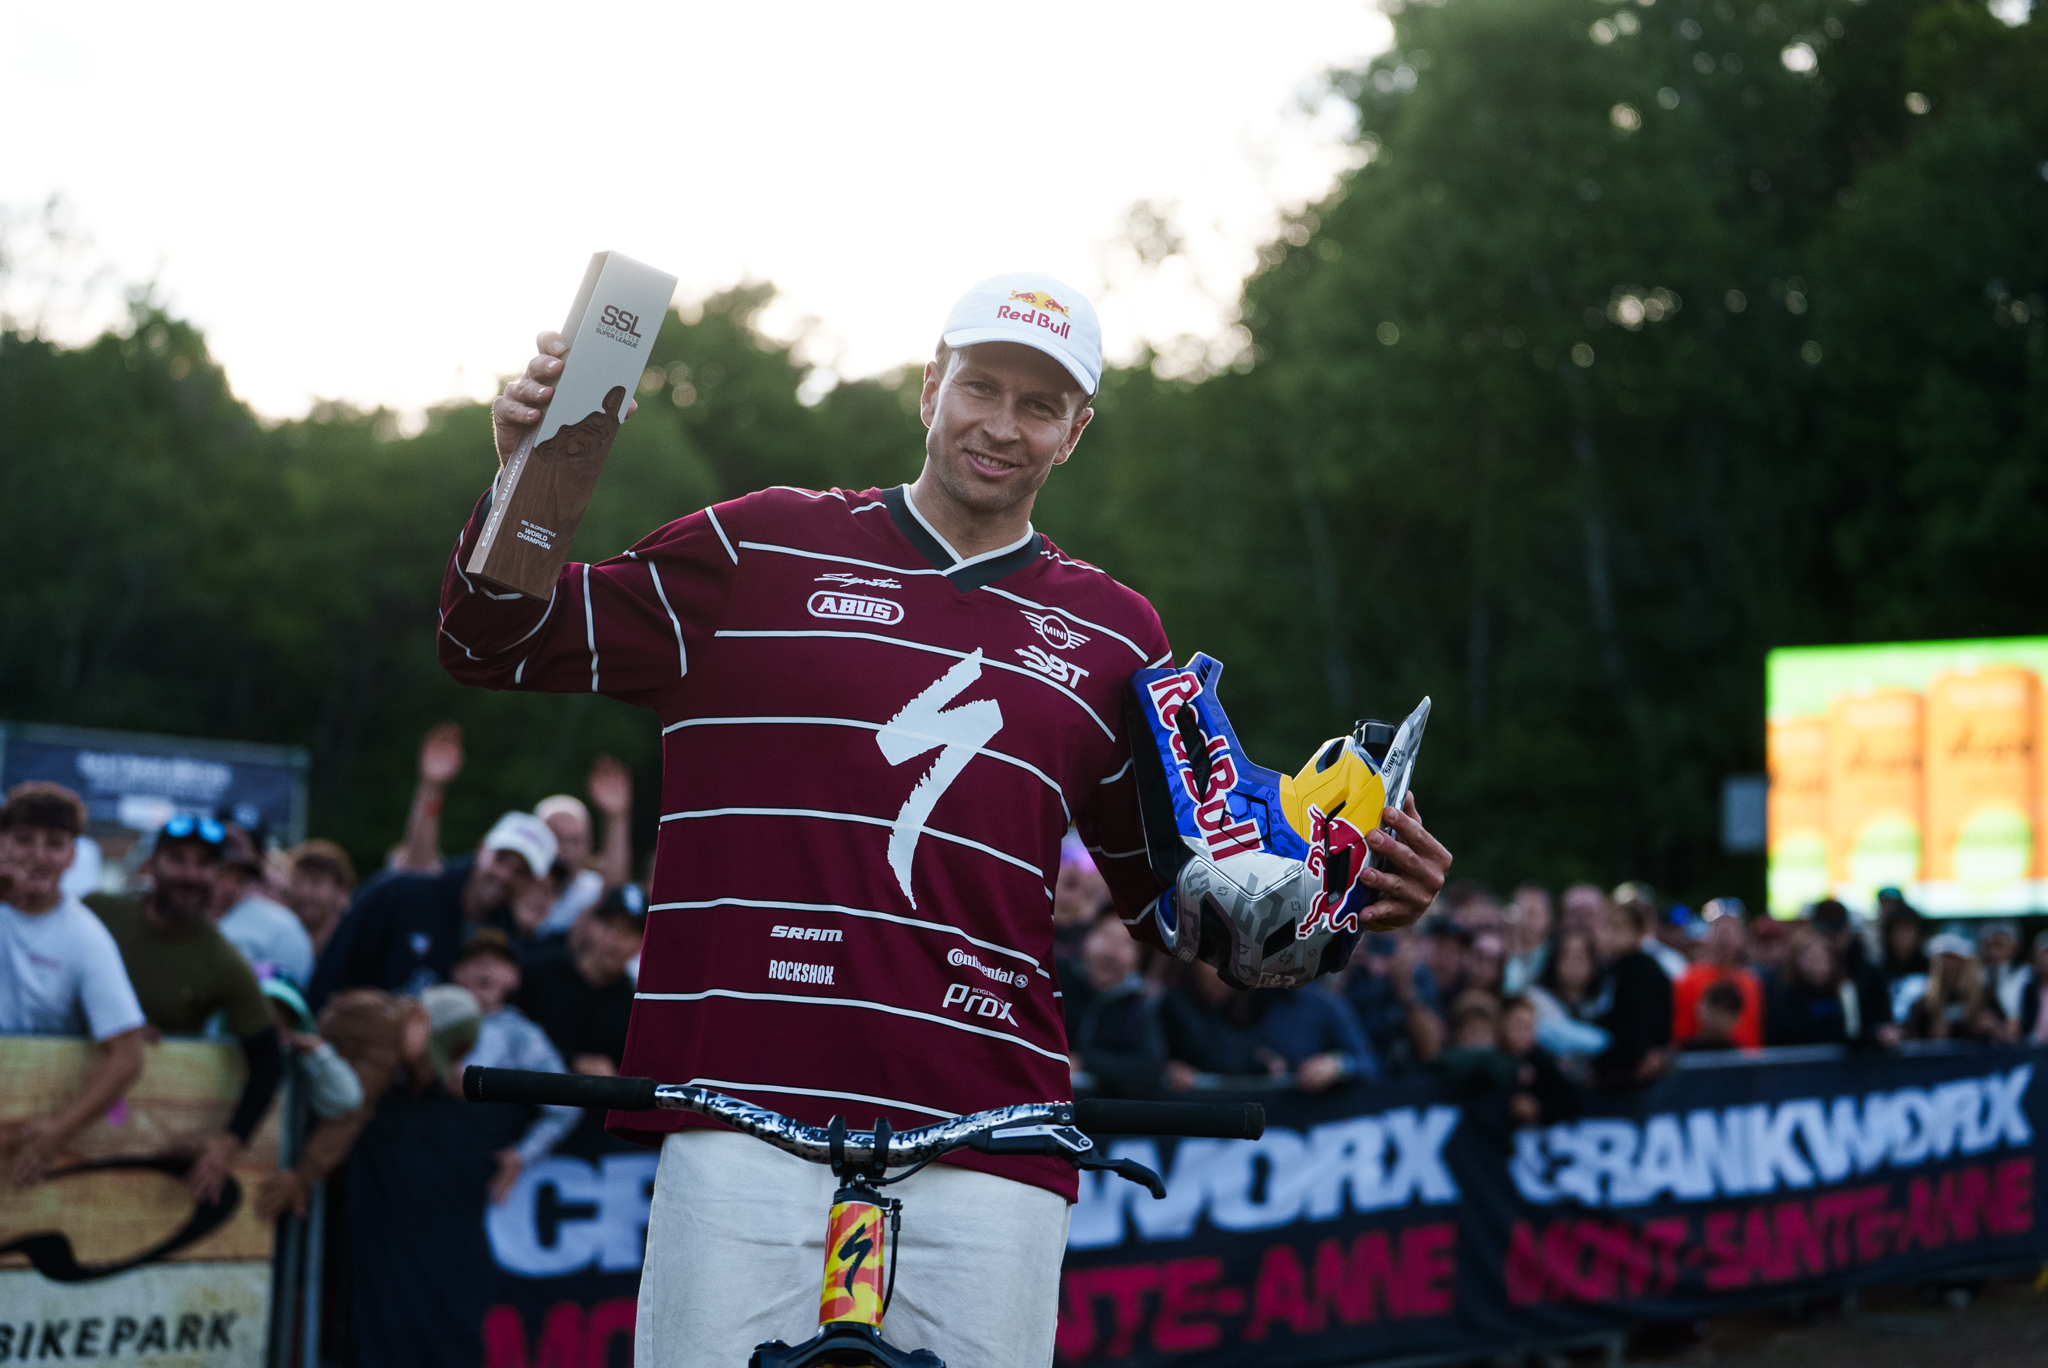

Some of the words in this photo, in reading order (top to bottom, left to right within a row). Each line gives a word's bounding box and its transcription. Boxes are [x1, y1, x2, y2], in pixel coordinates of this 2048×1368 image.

[601, 304, 642, 338] SSL
[997, 305, 1036, 323] Red
[1037, 313, 1071, 340] Bull
[596, 328, 616, 340] SUPER
[615, 335, 639, 349] LEAGUE
[517, 531, 551, 550] CHAMPION
[525, 527, 548, 542] WORLD
[818, 597, 892, 620] ABUS
[1043, 623, 1067, 642] MINI
[1384, 749, 1399, 774] ABUS
[770, 925, 843, 942] SRAM
[768, 959, 835, 985] ROCKSHOX
[947, 948, 1015, 984] Continental
[1508, 1064, 2035, 1208] CRANKWORX
